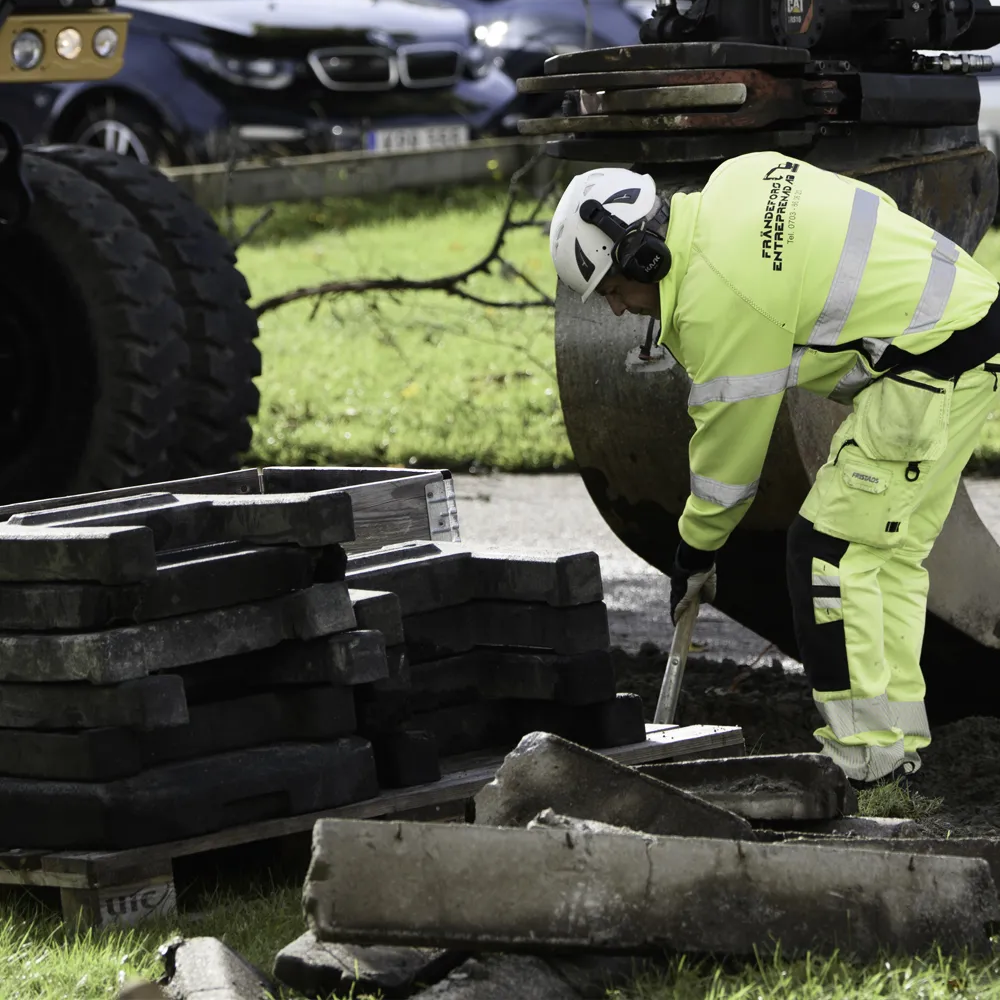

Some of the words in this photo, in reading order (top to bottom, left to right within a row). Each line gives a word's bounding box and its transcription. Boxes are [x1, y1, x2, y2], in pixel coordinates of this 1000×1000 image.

[773, 185, 793, 271] ENTREPRENAD
[787, 212, 797, 229] 0703
[787, 232, 795, 245] Tel.
[644, 255, 661, 273] KASK
